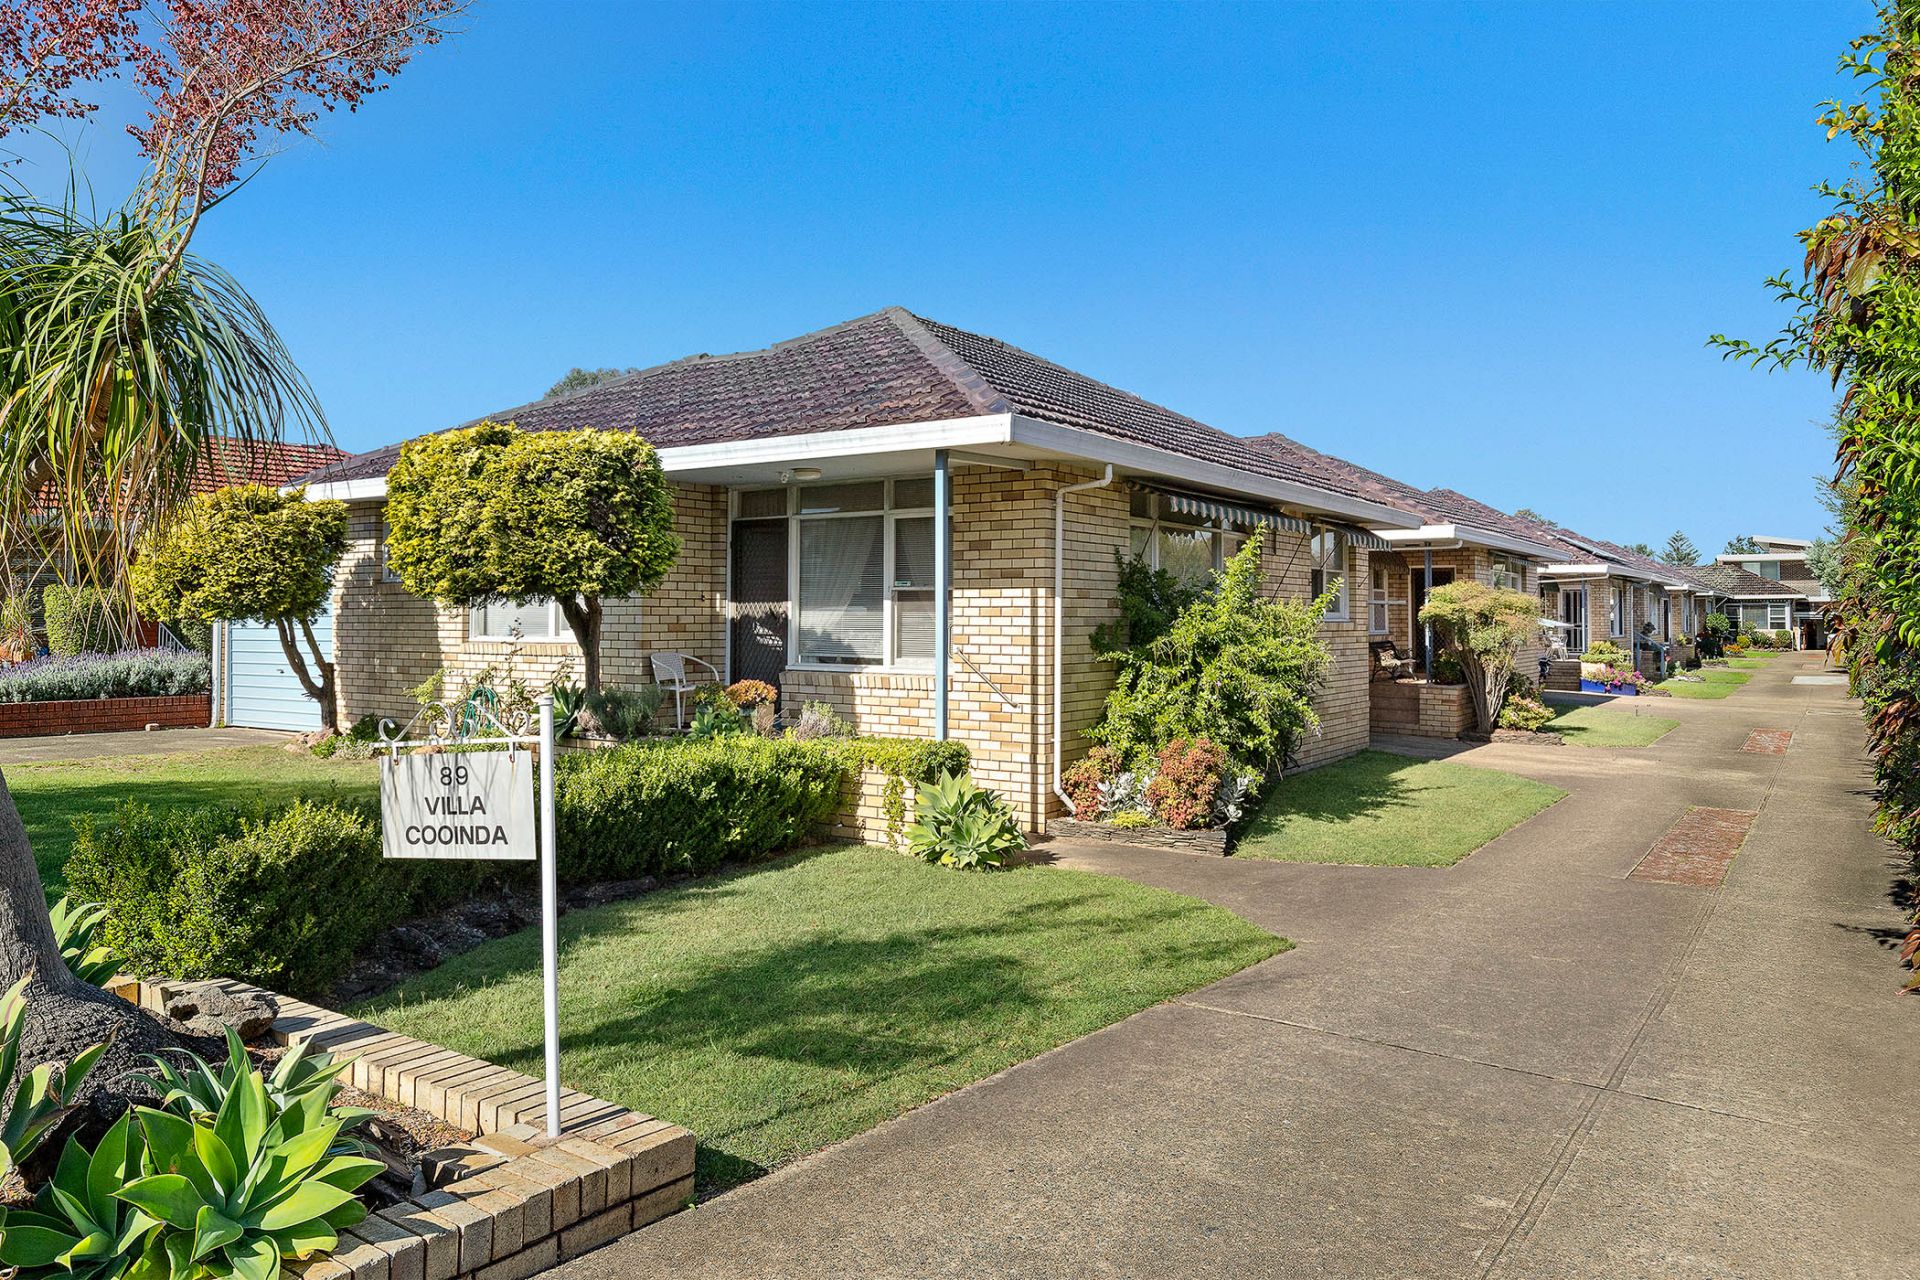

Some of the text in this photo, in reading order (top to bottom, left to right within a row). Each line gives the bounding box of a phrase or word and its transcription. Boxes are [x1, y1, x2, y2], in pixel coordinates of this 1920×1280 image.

[440, 766, 468, 786] 89
[424, 796, 487, 815] VILLA
[405, 825, 509, 845] COOINDA
